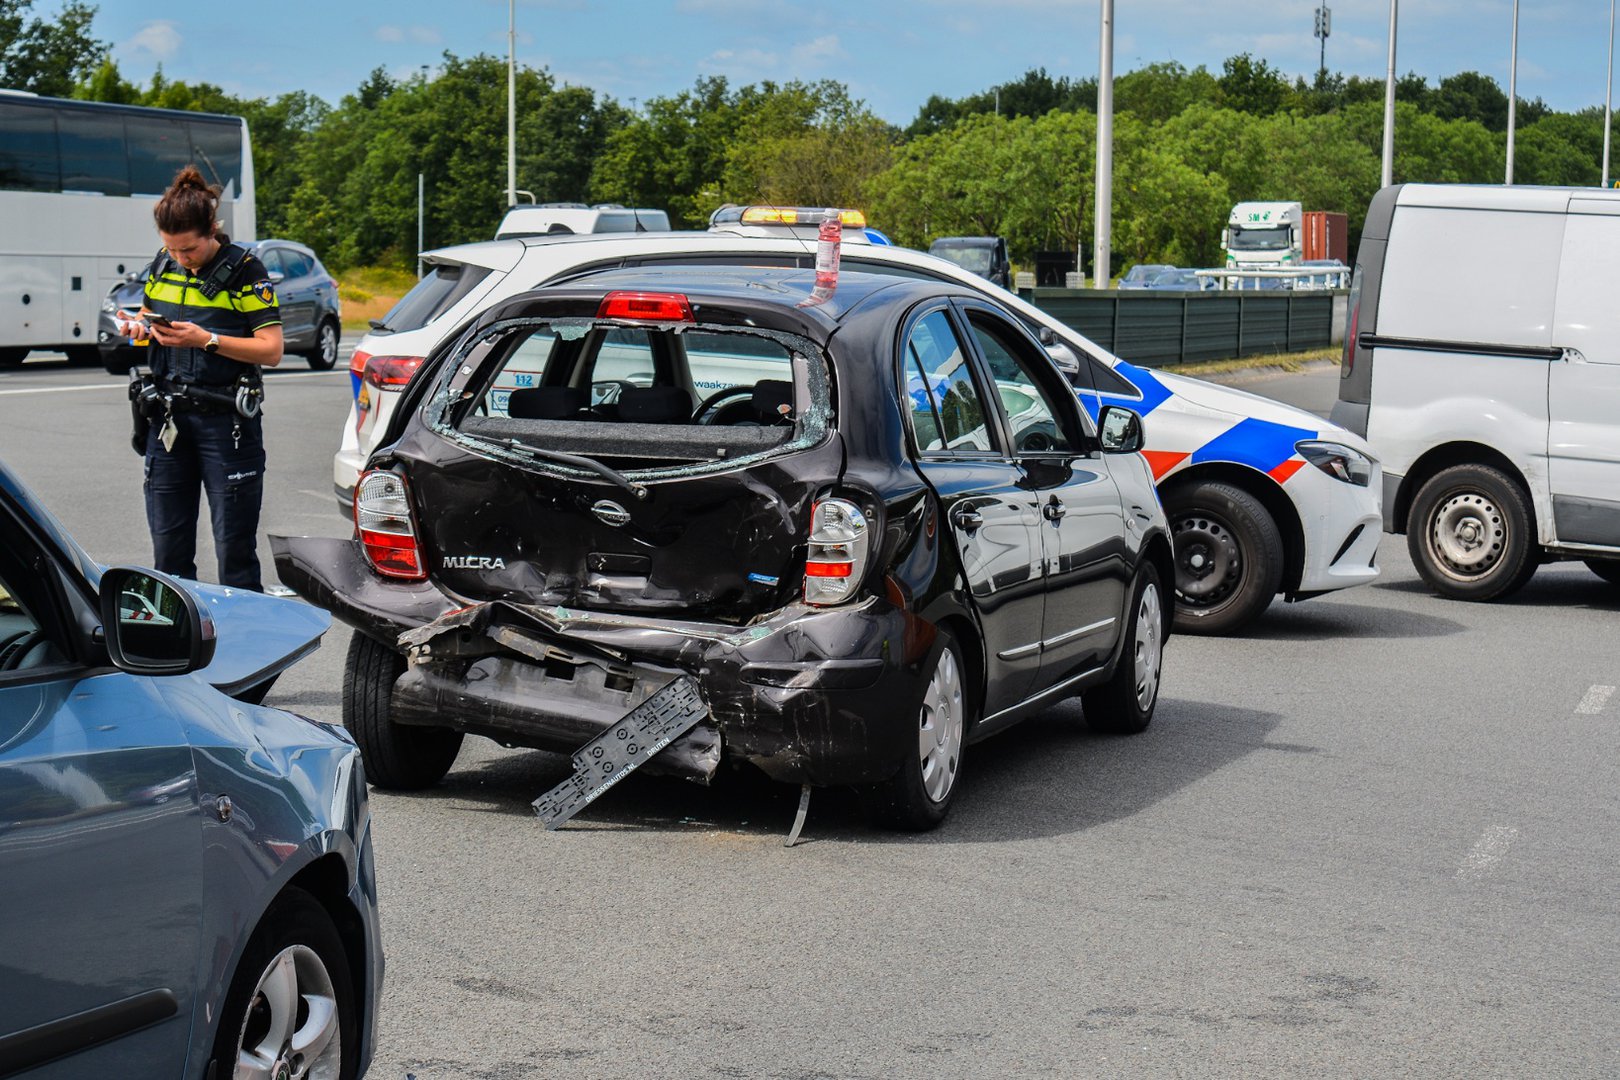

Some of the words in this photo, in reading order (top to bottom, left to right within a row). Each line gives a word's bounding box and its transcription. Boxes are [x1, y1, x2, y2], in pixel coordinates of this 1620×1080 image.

[515, 375, 532, 385] 112
[443, 556, 506, 569] MICRA
[585, 763, 638, 803] DRIESSENAUTOS.NL
[647, 738, 671, 756] DRUTEN
